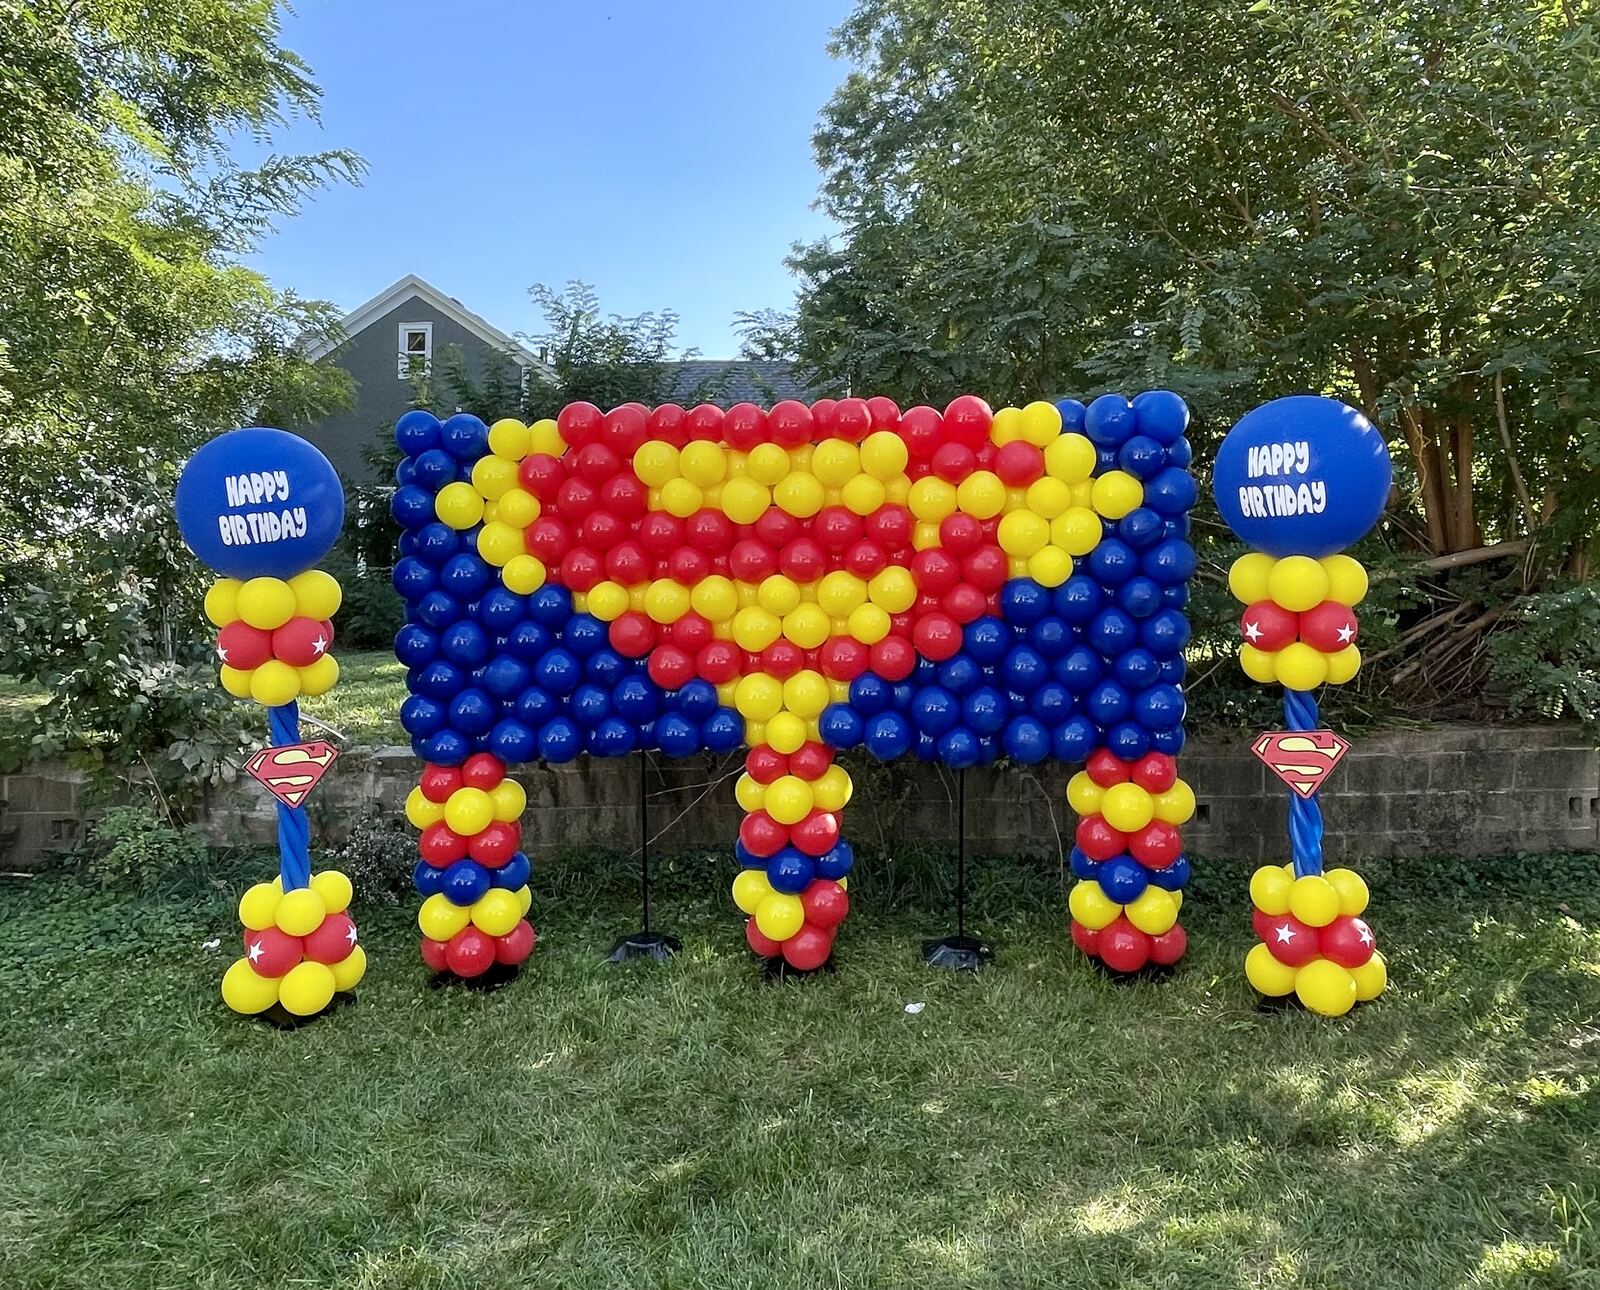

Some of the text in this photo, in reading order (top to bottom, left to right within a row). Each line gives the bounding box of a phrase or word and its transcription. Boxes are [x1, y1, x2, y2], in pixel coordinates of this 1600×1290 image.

[1248, 441, 1310, 478] HAPPY
[225, 470, 290, 507] HAPPY
[1239, 481, 1326, 517] BIRTHDAY
[218, 507, 307, 545] BIRTHDAY
